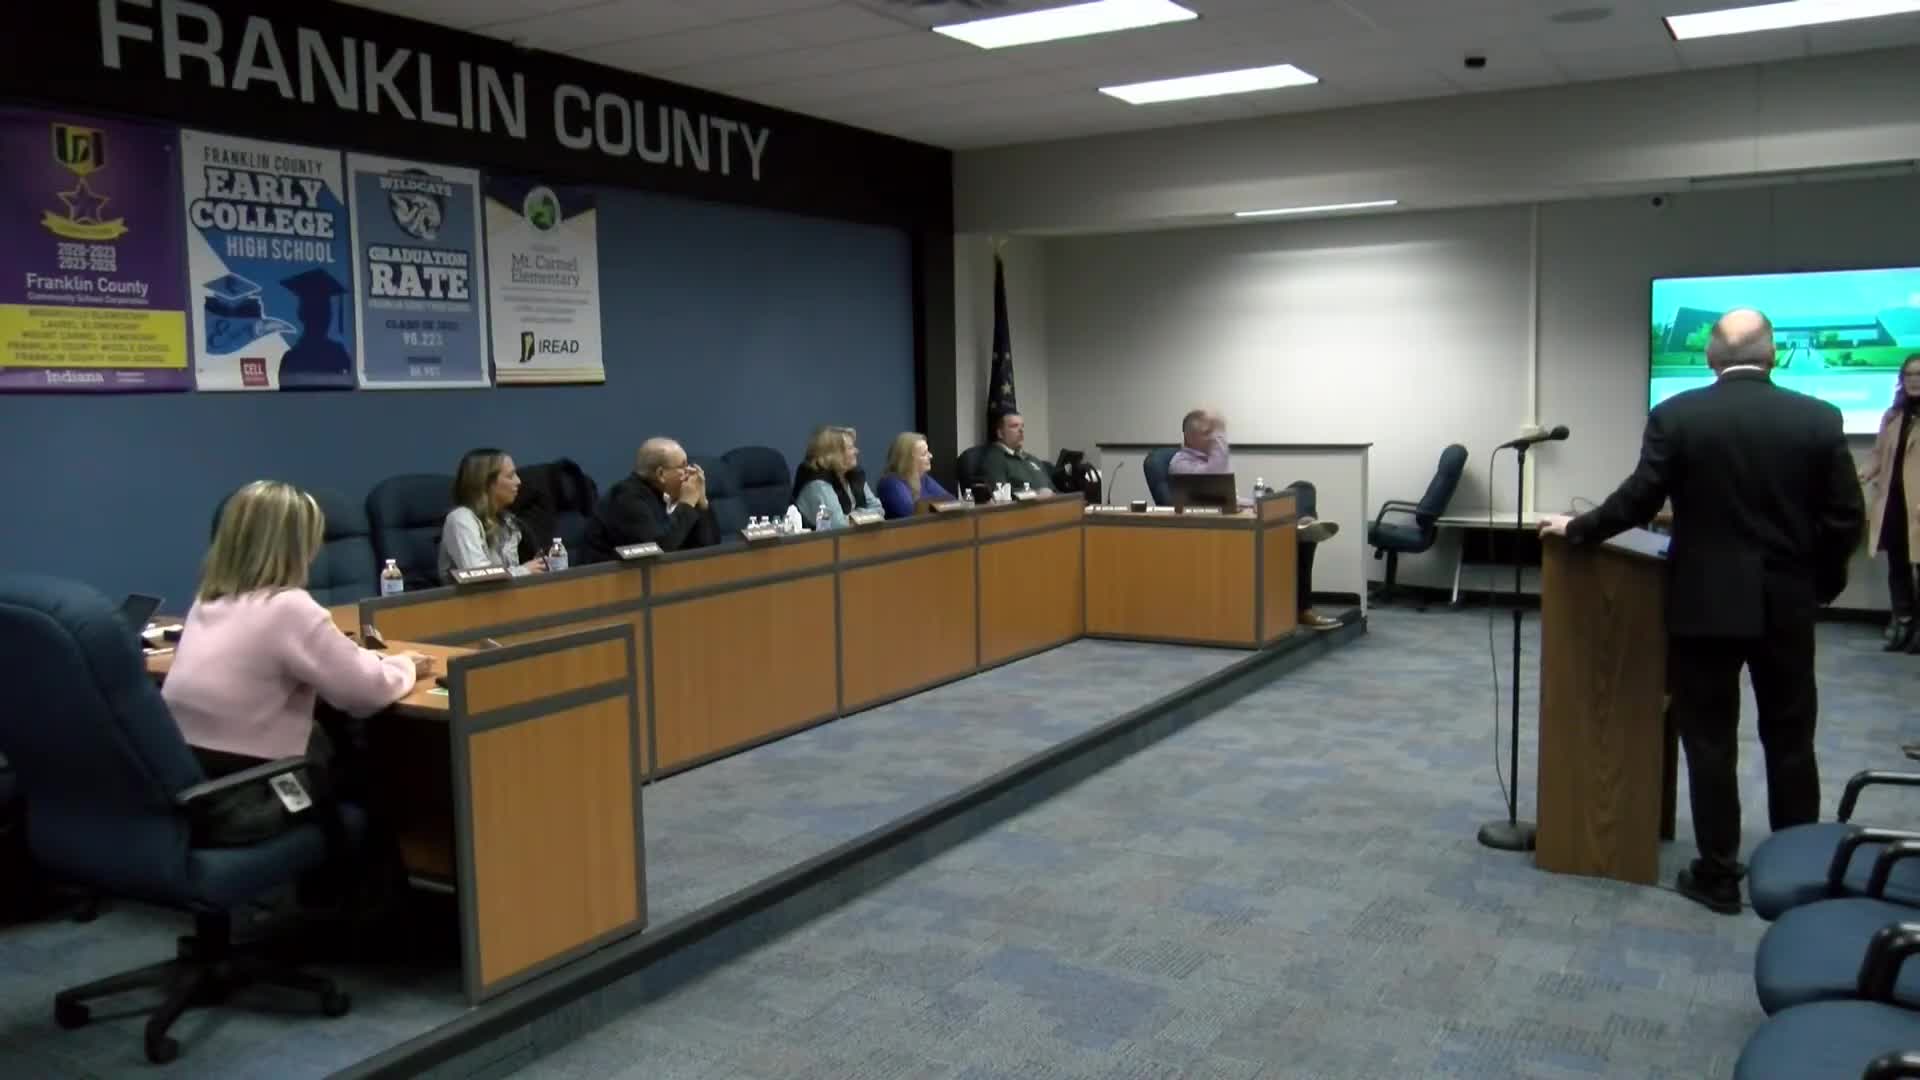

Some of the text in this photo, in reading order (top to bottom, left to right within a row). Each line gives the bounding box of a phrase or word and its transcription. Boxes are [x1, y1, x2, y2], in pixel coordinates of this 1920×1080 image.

[101, 0, 771, 181] FRANKLIN COUNTY
[204, 145, 323, 175] FRANKLIN COUNTY
[206, 167, 322, 208] EARLY
[380, 176, 453, 197] WILDCATS
[191, 200, 335, 239] COLLEGE
[226, 234, 336, 263] HIGH SCHOOL
[368, 246, 469, 268] GRADUATION
[26, 272, 149, 297] Franklin County
[370, 262, 470, 299] RATE
[538, 339, 580, 354] IREAD
[44, 369, 105, 385] Indiana
[243, 363, 264, 375] CELL
